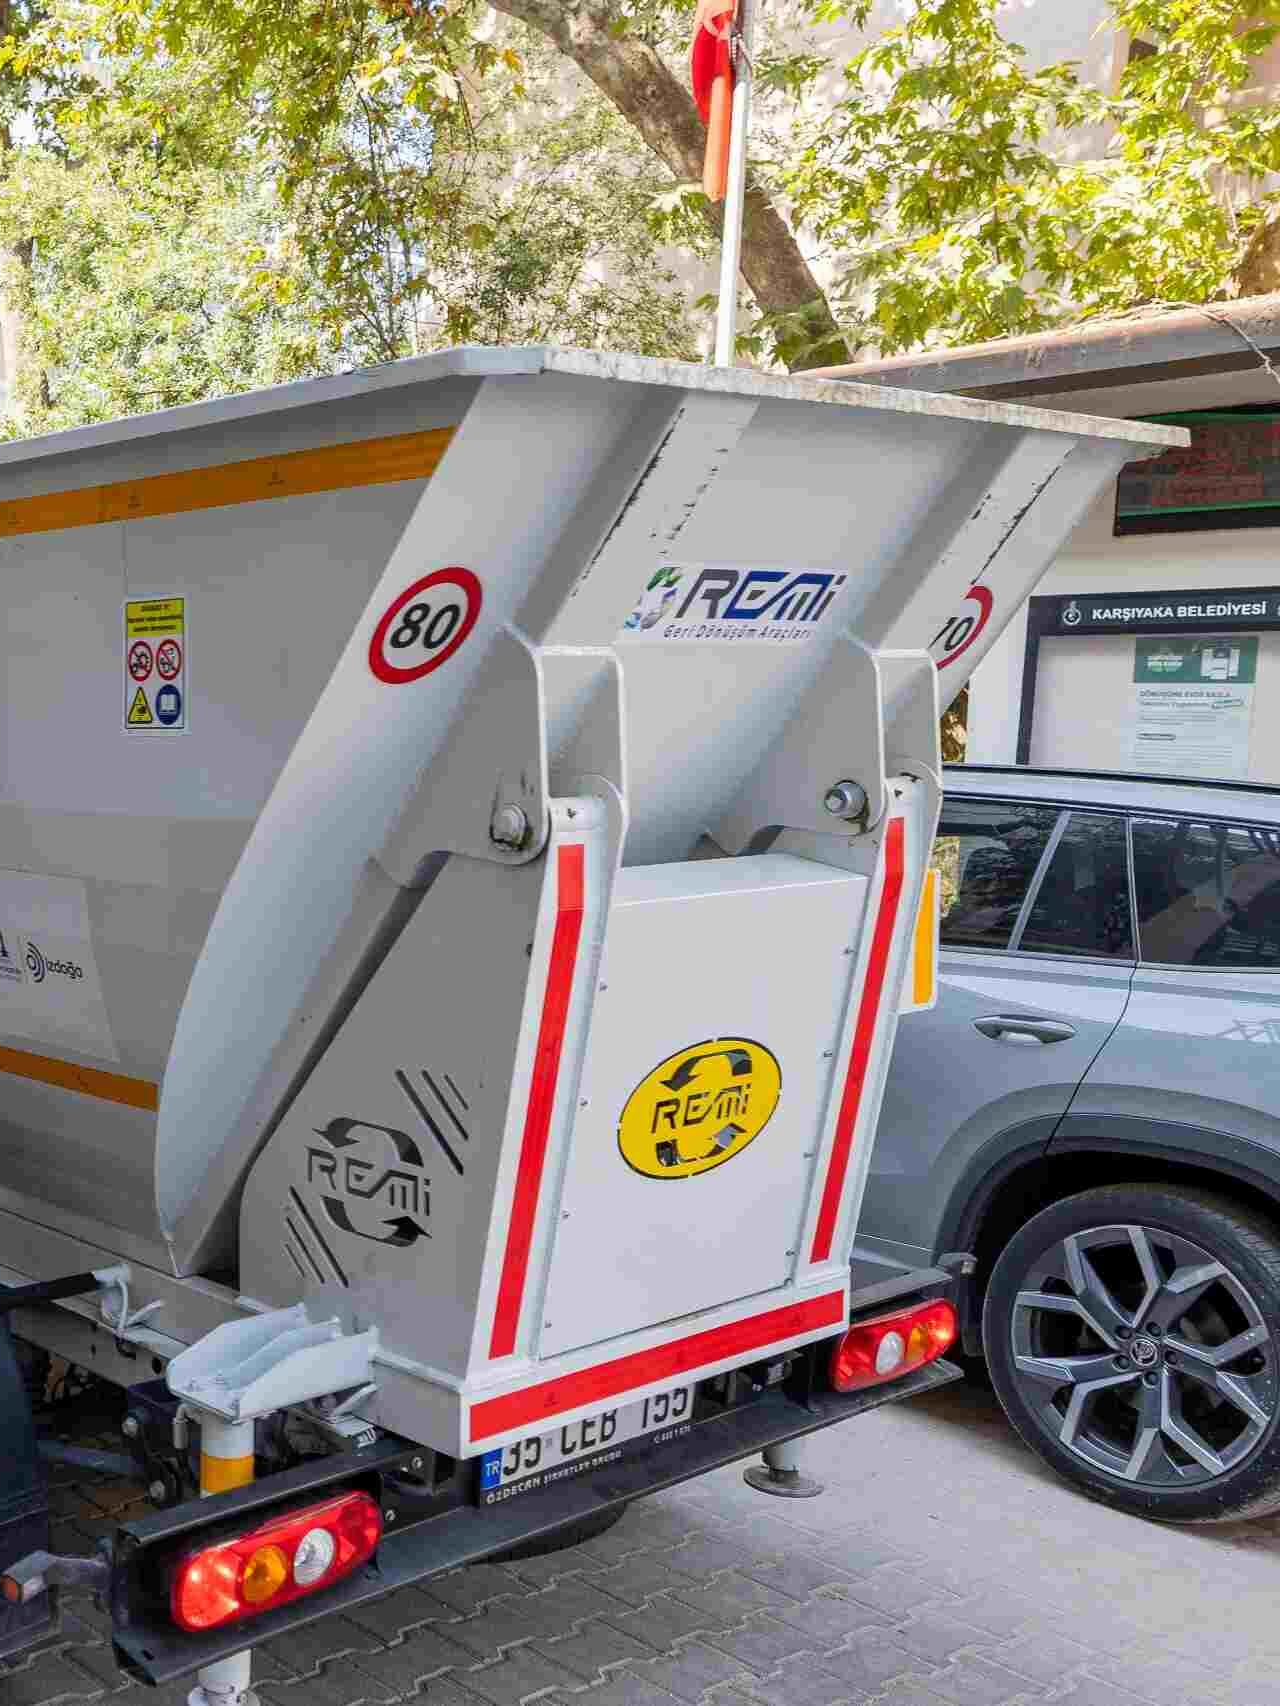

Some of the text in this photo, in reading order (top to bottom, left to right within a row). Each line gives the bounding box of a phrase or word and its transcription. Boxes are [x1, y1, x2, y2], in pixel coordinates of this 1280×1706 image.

[1092, 601, 1267, 622] KARŞIYAKA BELEDİYESİ
[389, 602, 460, 649] 80
[663, 623, 694, 639] Geri
[485, 1459, 500, 1478] TR
